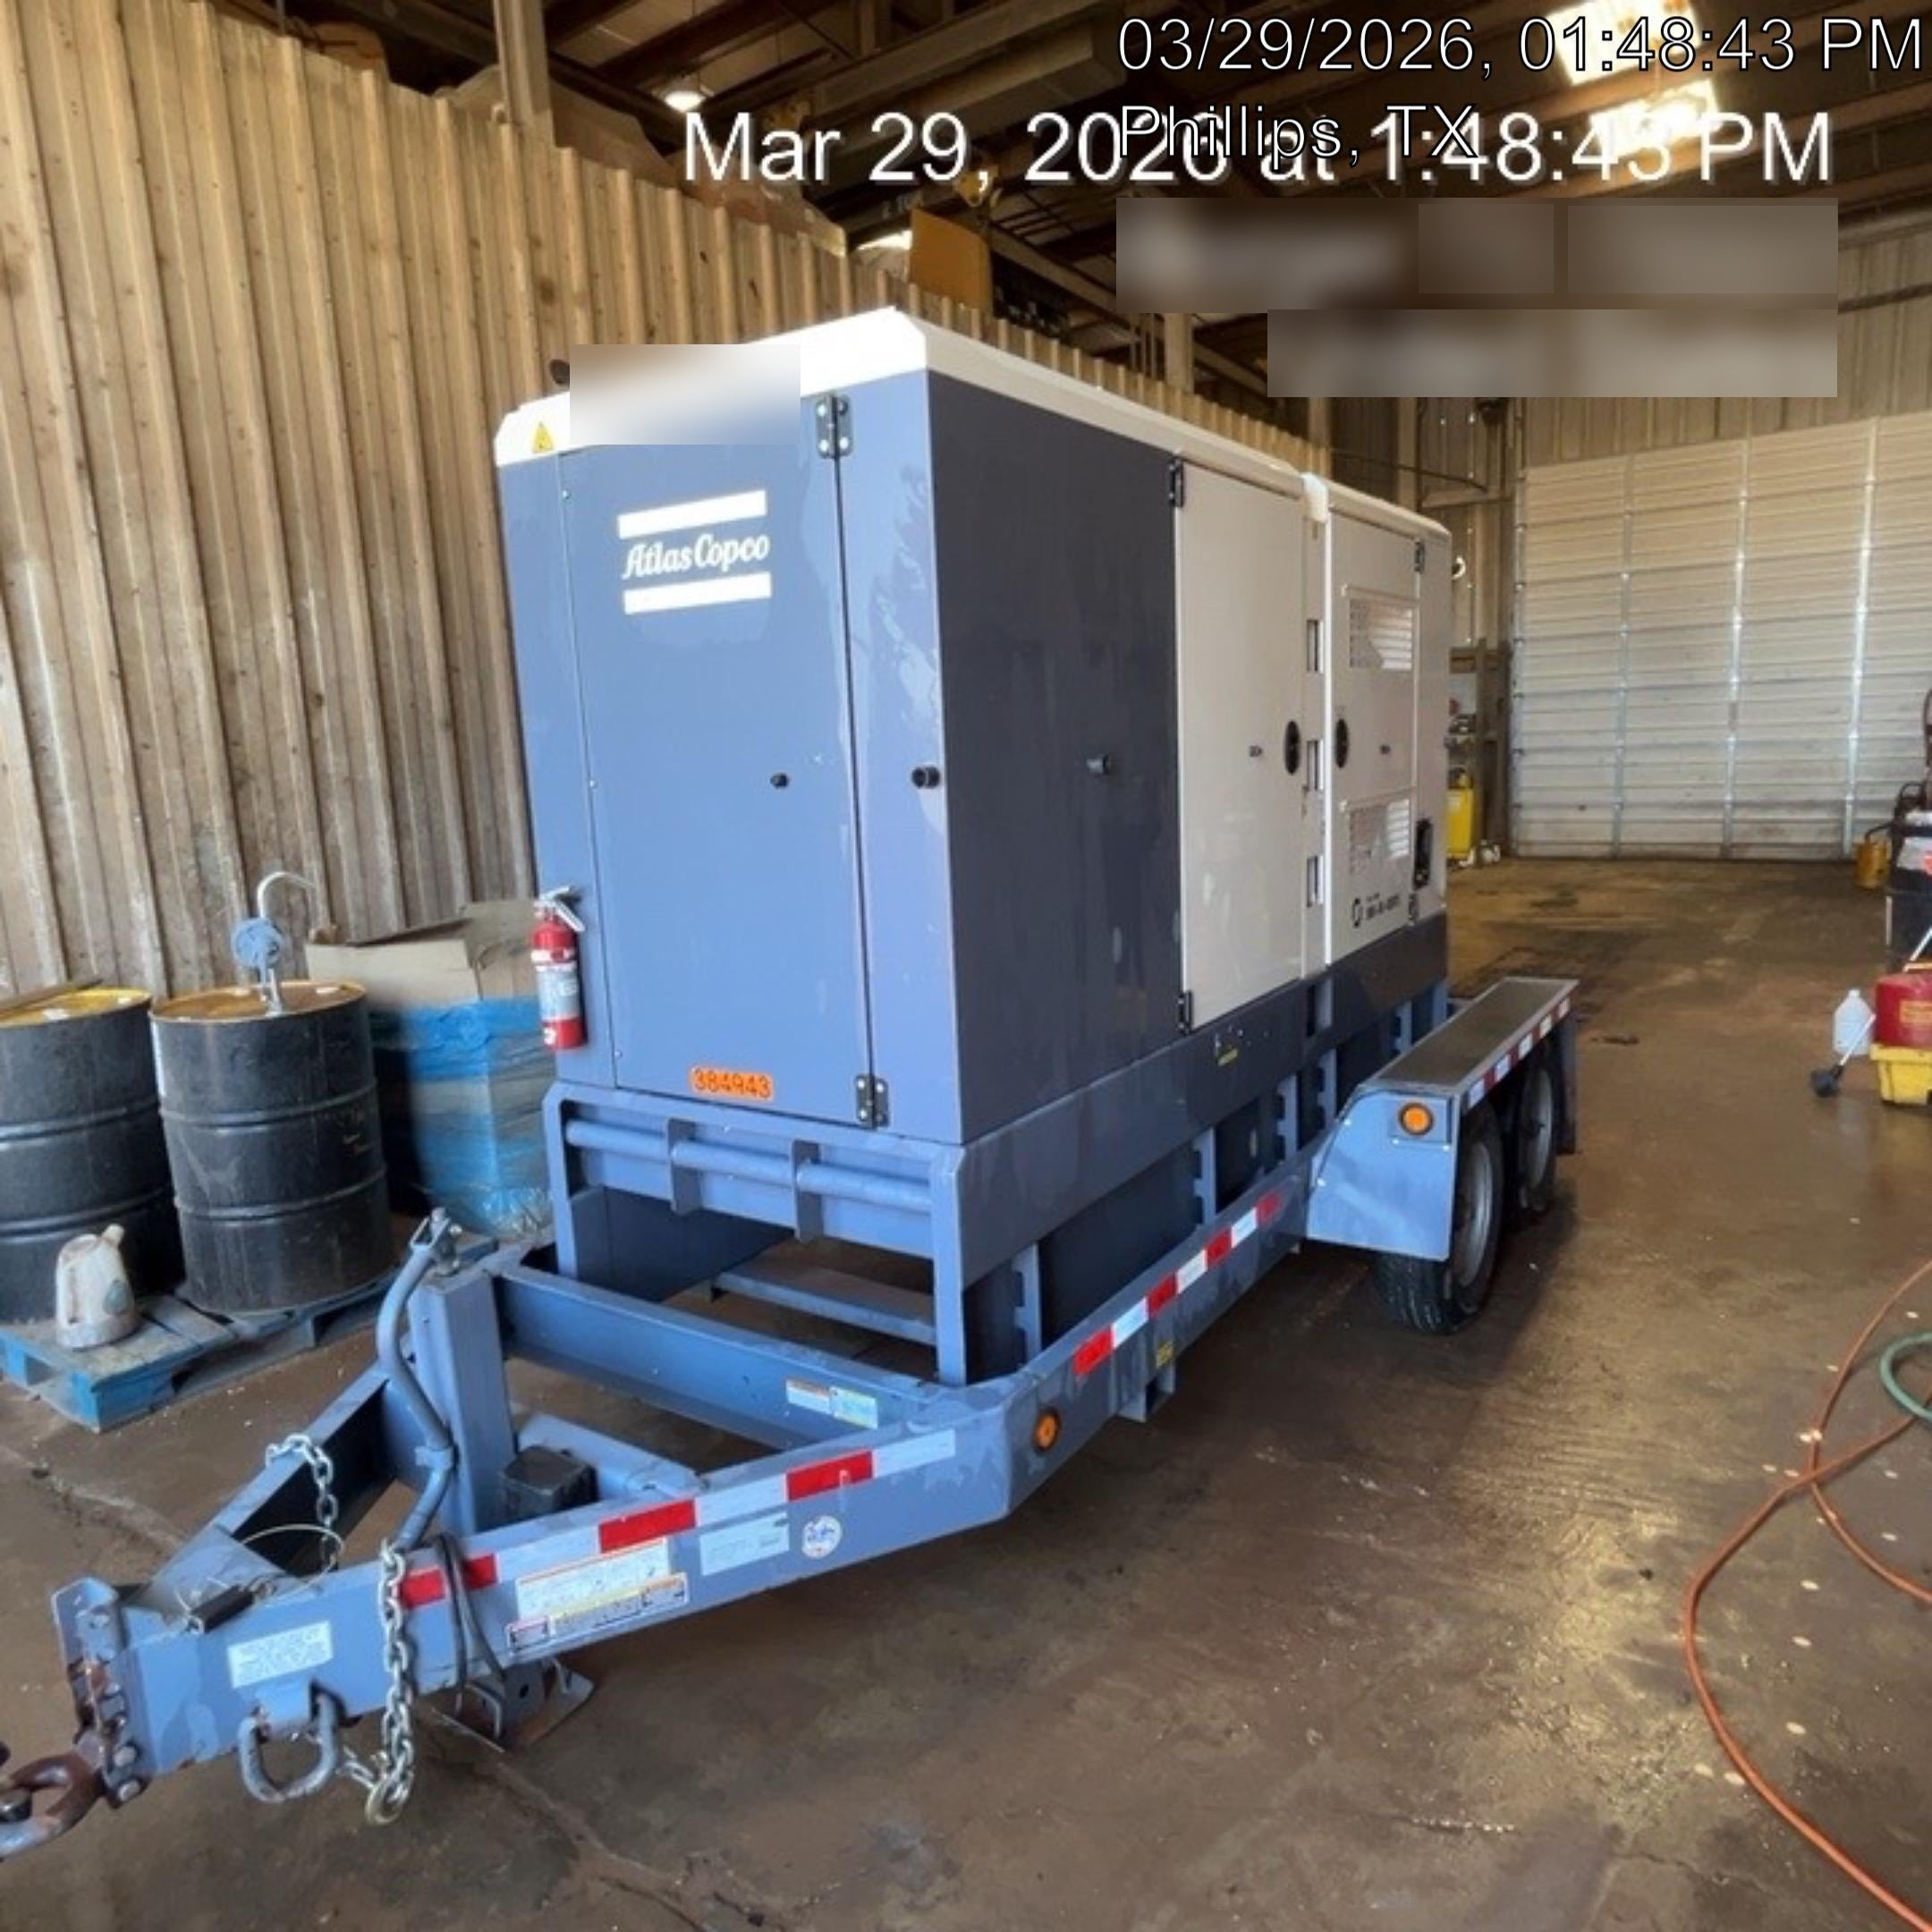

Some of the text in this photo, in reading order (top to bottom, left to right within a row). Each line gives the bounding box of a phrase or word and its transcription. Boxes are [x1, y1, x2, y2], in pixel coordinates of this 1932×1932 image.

[622, 533, 770, 580] Atlas Copco
[693, 1067, 772, 1099] 384943
